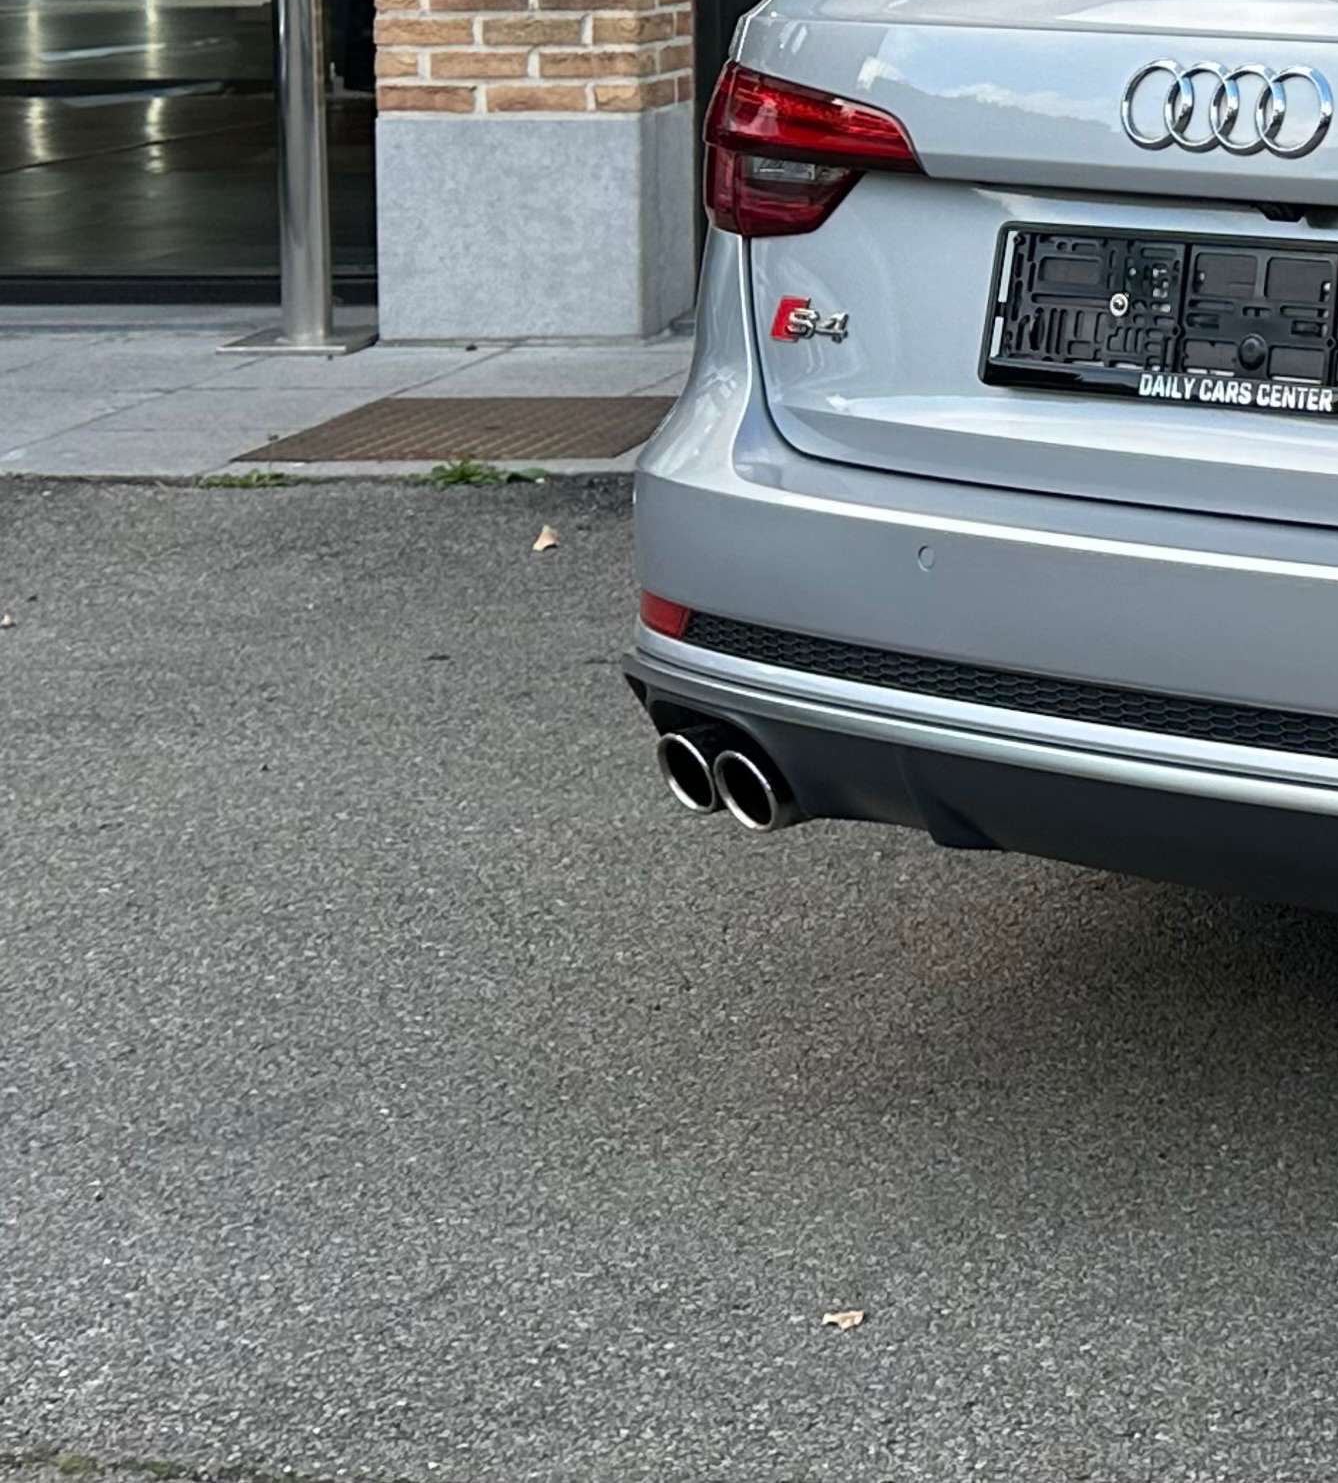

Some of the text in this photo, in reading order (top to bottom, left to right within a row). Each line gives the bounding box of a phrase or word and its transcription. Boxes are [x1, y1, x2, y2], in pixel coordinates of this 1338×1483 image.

[785, 305, 849, 344] S4
[1138, 373, 1334, 412] DAILY CARS CENTER
